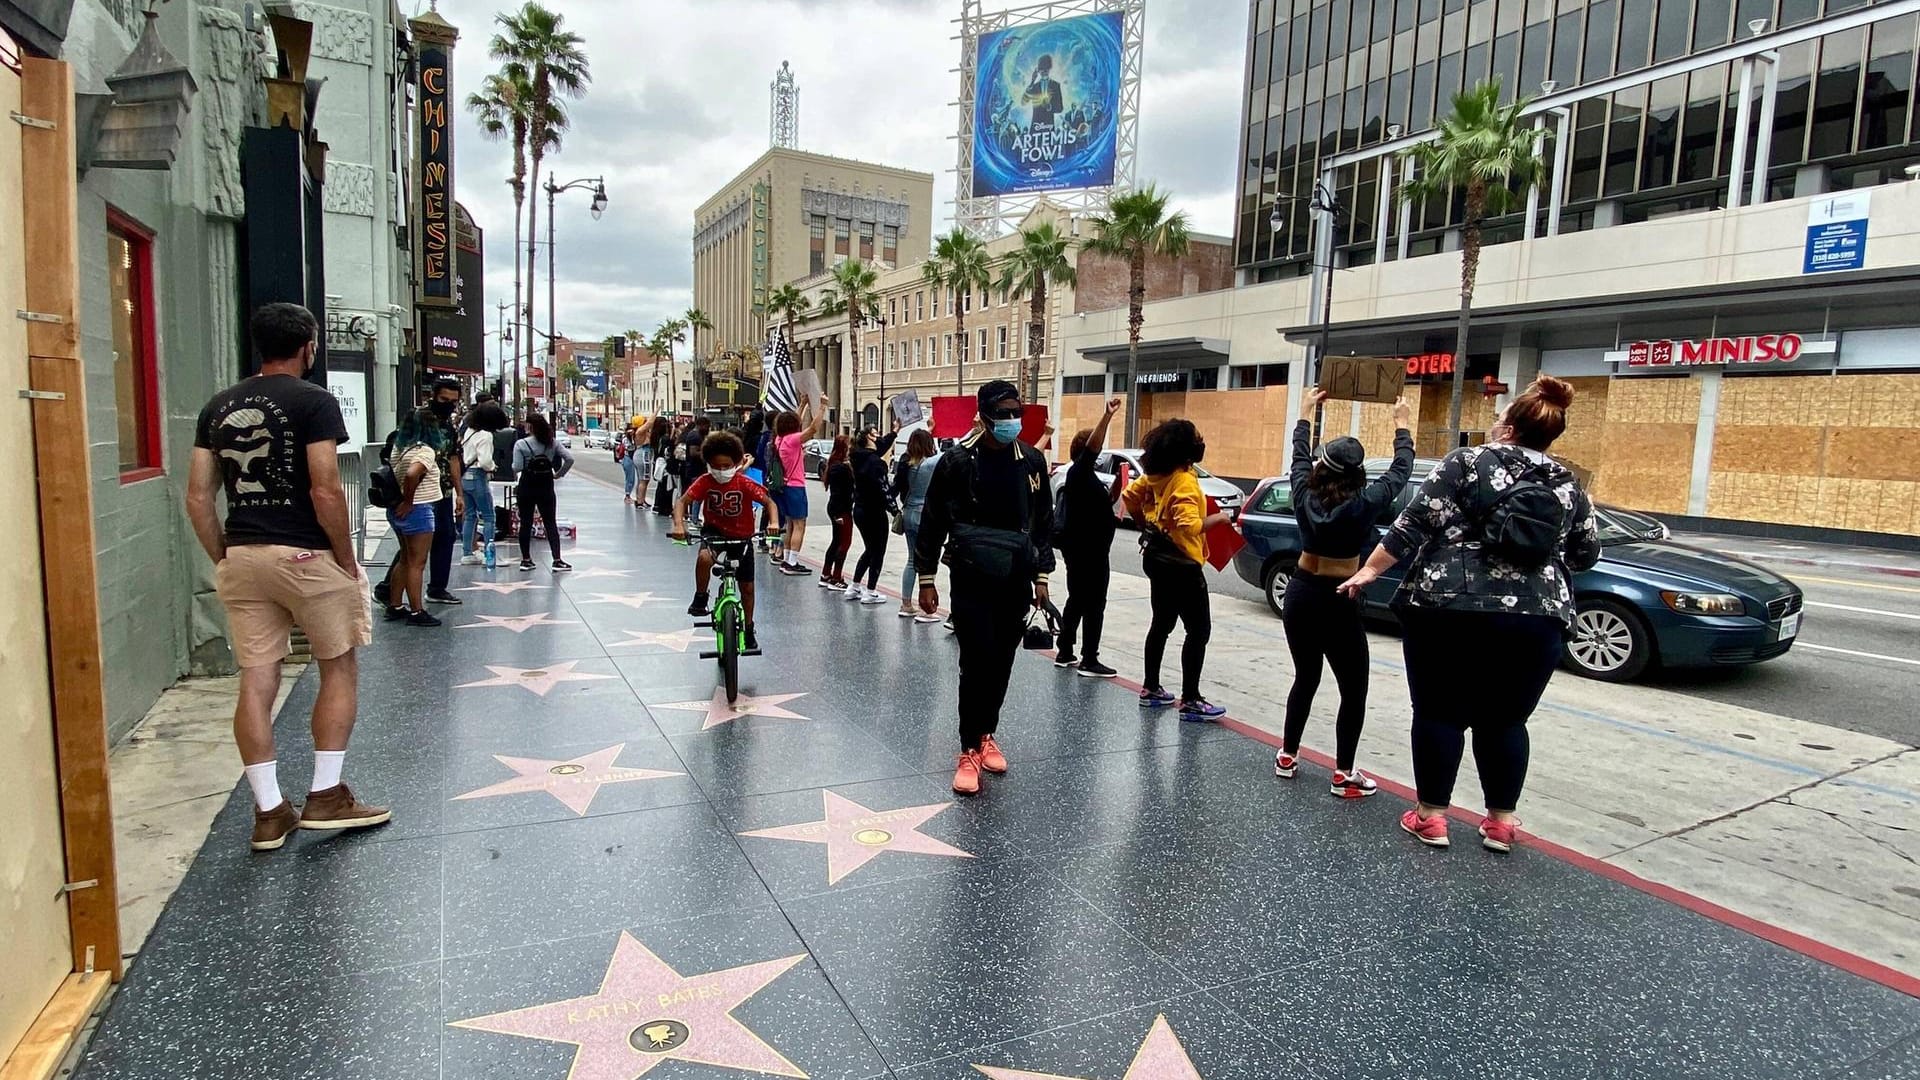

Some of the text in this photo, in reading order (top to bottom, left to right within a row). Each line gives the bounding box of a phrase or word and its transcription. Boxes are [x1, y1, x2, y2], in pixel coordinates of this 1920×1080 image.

[1012, 129, 1077, 149] ARTEMIS
[1033, 122, 1054, 131] Disney
[1021, 145, 1064, 162] FOWL
[423, 68, 446, 278] CHINESE
[753, 207, 767, 306] CAPITAN
[1406, 353, 1457, 375] OTER
[1680, 334, 1802, 365] MINISO
[1135, 372, 1177, 384] INE FRIENDS
[1329, 360, 1403, 398] BLM
[244, 395, 289, 424] MOTHER
[283, 431, 294, 473] EARTH
[707, 489, 744, 517] 23
[567, 982, 723, 1025] KATHY BATES
